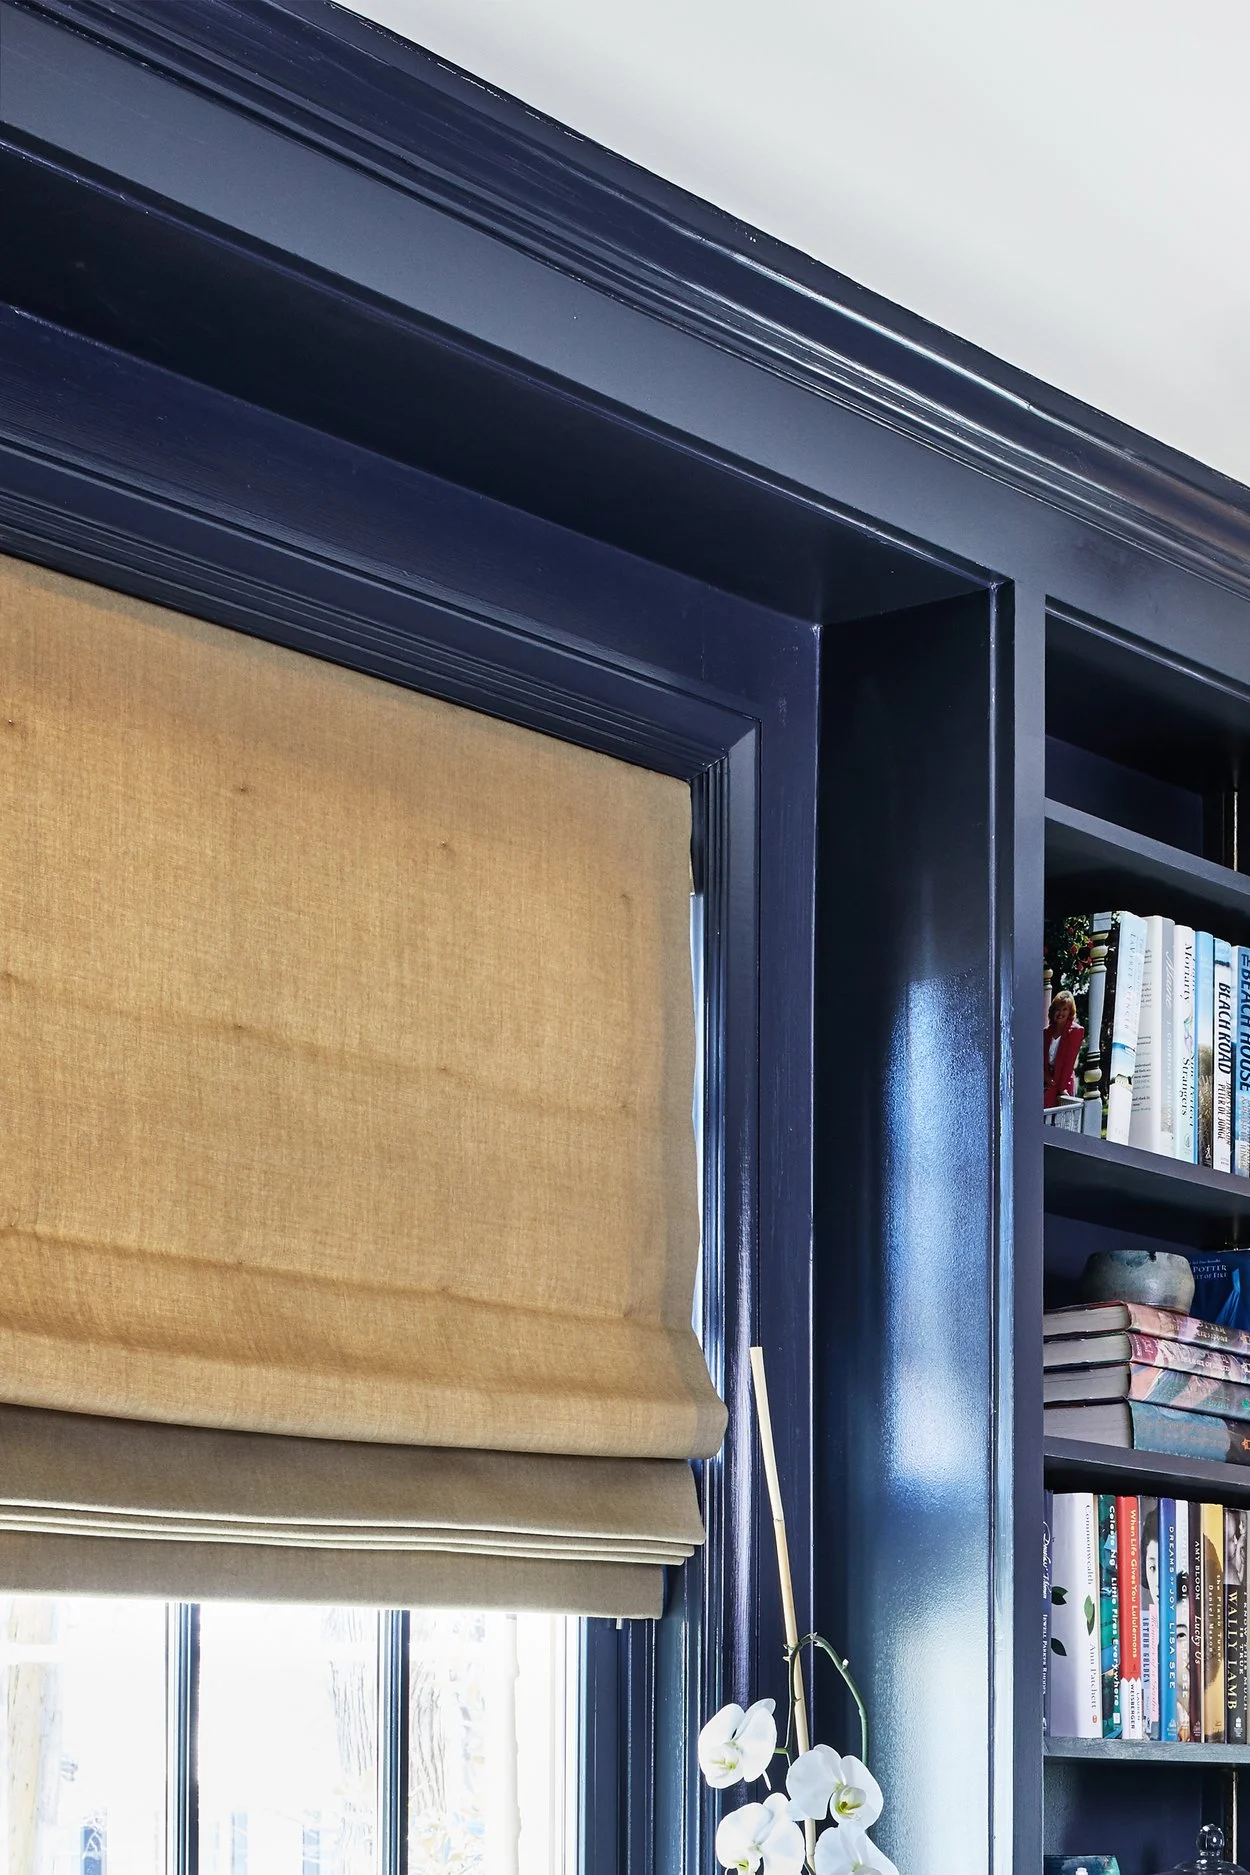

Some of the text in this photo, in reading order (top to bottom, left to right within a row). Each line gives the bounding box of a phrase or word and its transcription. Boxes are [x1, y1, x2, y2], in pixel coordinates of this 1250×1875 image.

[1180, 943, 1193, 1002] Moriarty
[1218, 982, 1231, 1075] BEACH ROAD
[1180, 1057, 1190, 1116] Strangers
[1217, 1117, 1225, 1140] JONGE
[1193, 1264, 1227, 1272] POTTER
[1086, 1505, 1094, 1585] Commonwealth
[1142, 1617, 1150, 1649] ARTHUR
[1191, 1615, 1202, 1665] Lucky Us
[1227, 1590, 1238, 1710] WALLY LAMB
[1090, 1668, 1098, 1709] Patchett
[1112, 1638, 1121, 1707] Everywhere
